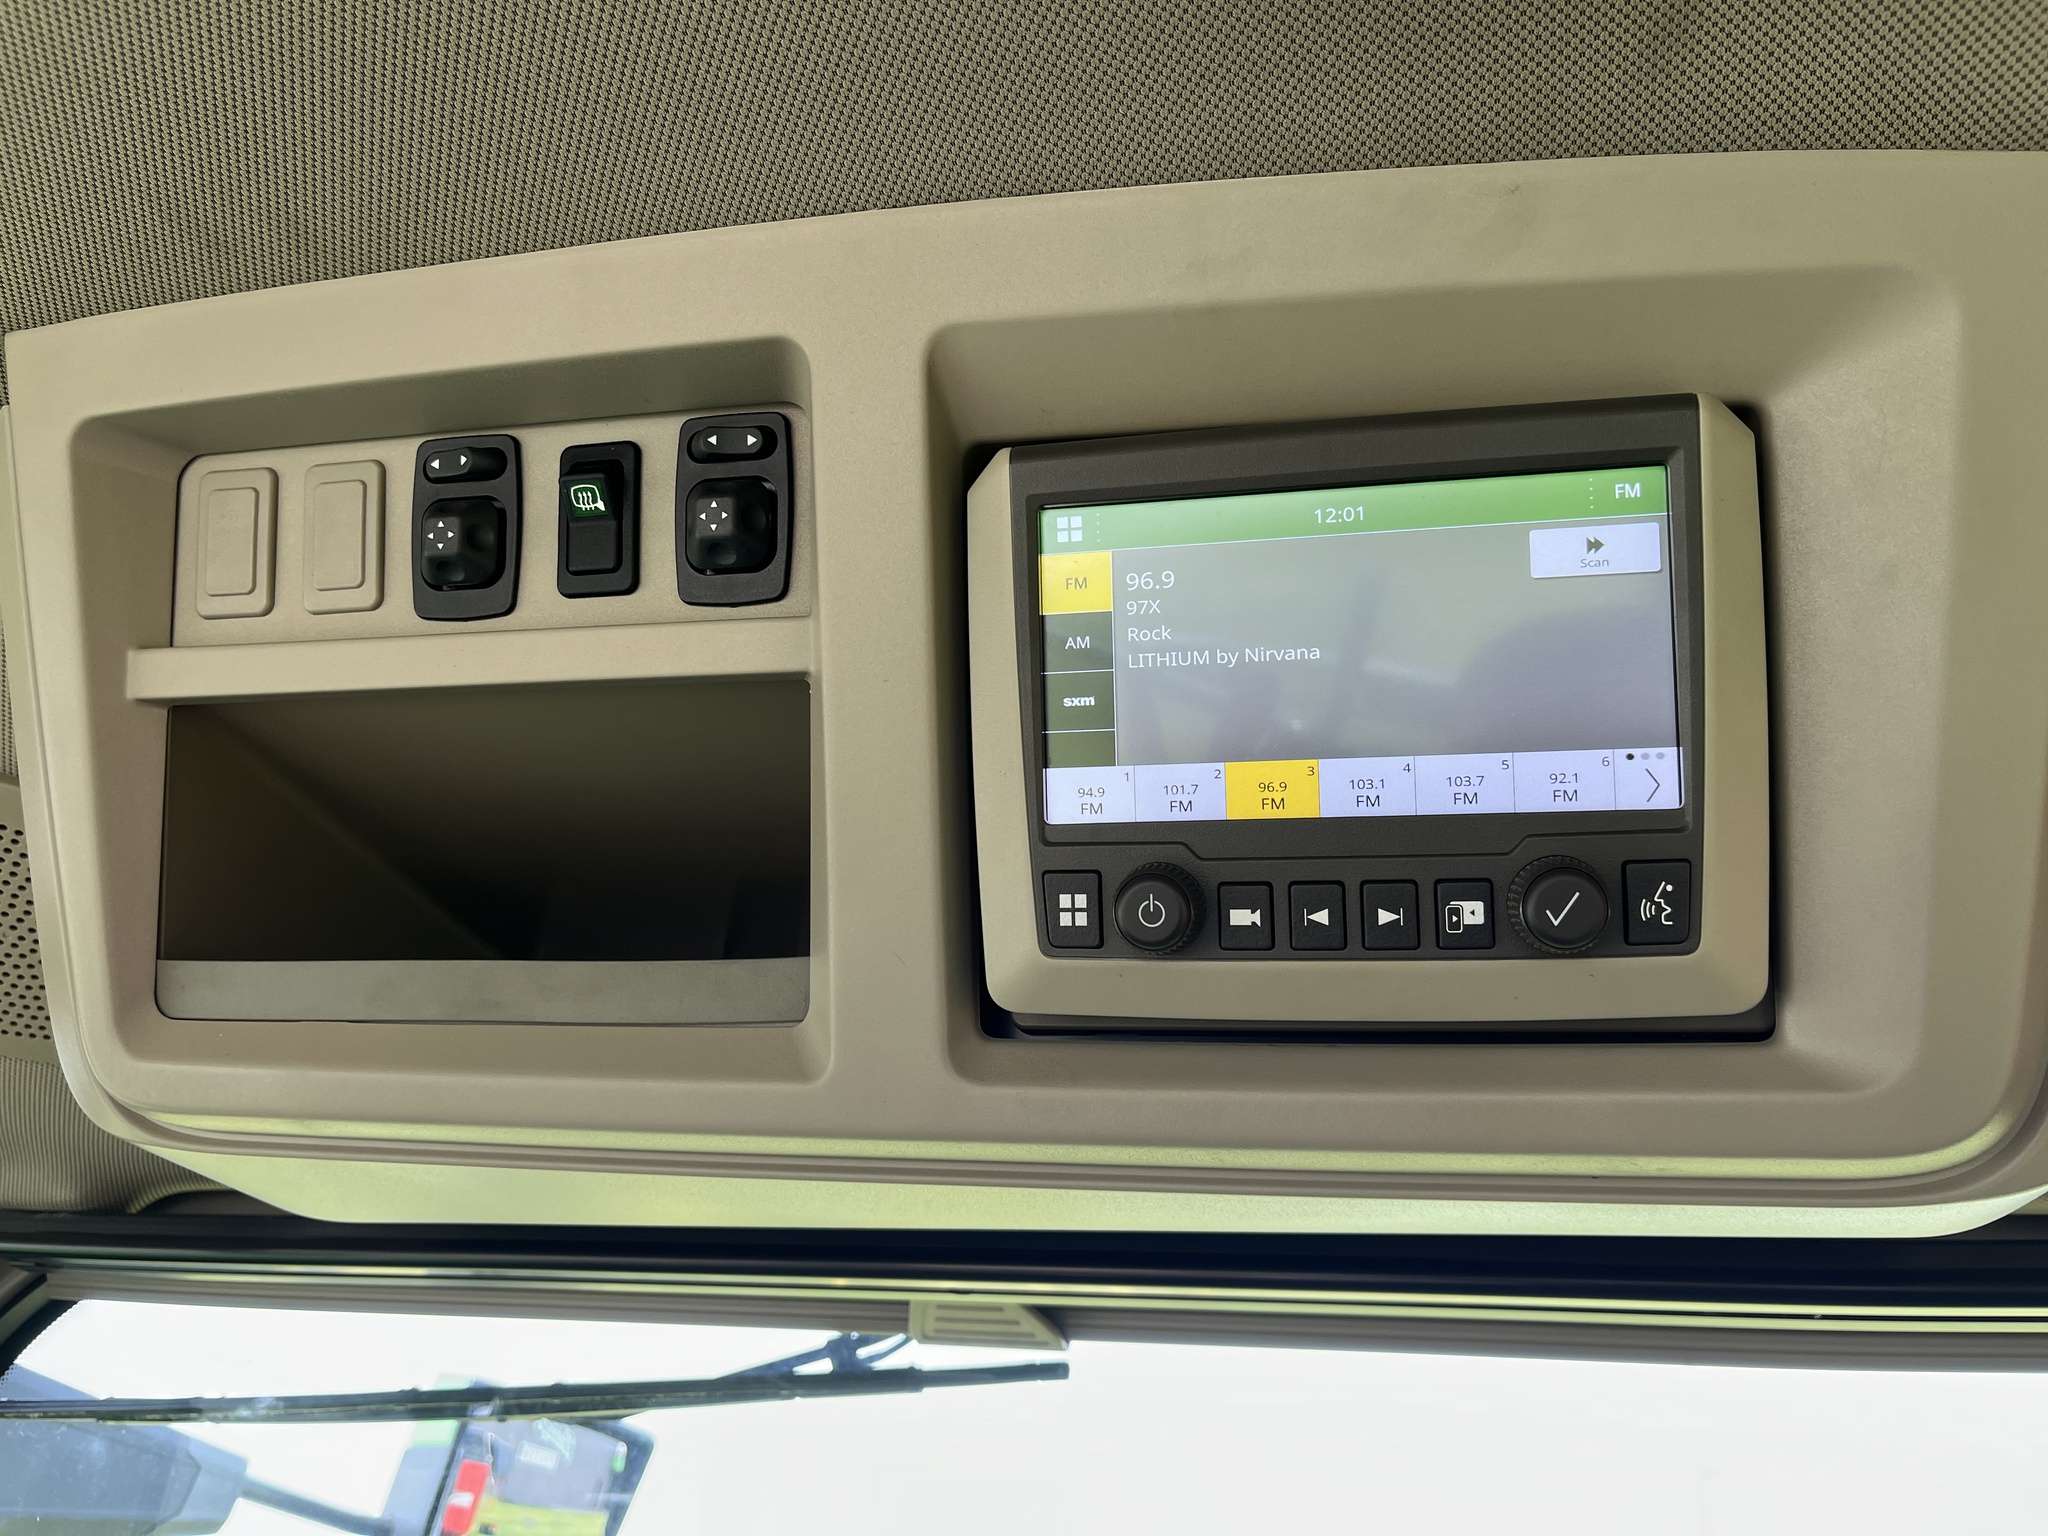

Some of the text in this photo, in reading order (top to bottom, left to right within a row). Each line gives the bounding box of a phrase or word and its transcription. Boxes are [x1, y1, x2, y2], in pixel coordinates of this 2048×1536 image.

[1615, 482, 1641, 499] FM
[1314, 505, 1364, 524] 12:01
[1580, 556, 1610, 569] Scan
[1065, 576, 1088, 590] FM
[1125, 570, 1175, 591] 96.9
[1126, 599, 1161, 615] 97X
[1127, 625, 1172, 642] Rock
[1065, 636, 1091, 650] AM
[1128, 646, 1321, 668] LITHIUM by Nirvana
[1062, 695, 1096, 707] sxm
[1402, 762, 1411, 773] 4
[1501, 759, 1510, 770] 5
[1601, 756, 1610, 767] 6
[1124, 772, 1130, 782] 1
[1214, 769, 1222, 779] 2
[1306, 766, 1315, 776] 3
[1349, 778, 1386, 791] 103.1
[1446, 775, 1485, 787] 103.7
[1549, 772, 1579, 784] 92.1
[1077, 786, 1106, 798] 94.9
[1163, 783, 1199, 796] 101.7
[1258, 781, 1288, 793] 96.9
[1355, 794, 1381, 808] FM
[1453, 791, 1478, 805] FM
[1552, 789, 1579, 802] FM
[1080, 802, 1104, 815] FM
[1170, 799, 1193, 813] FM
[1261, 797, 1286, 810] FM
